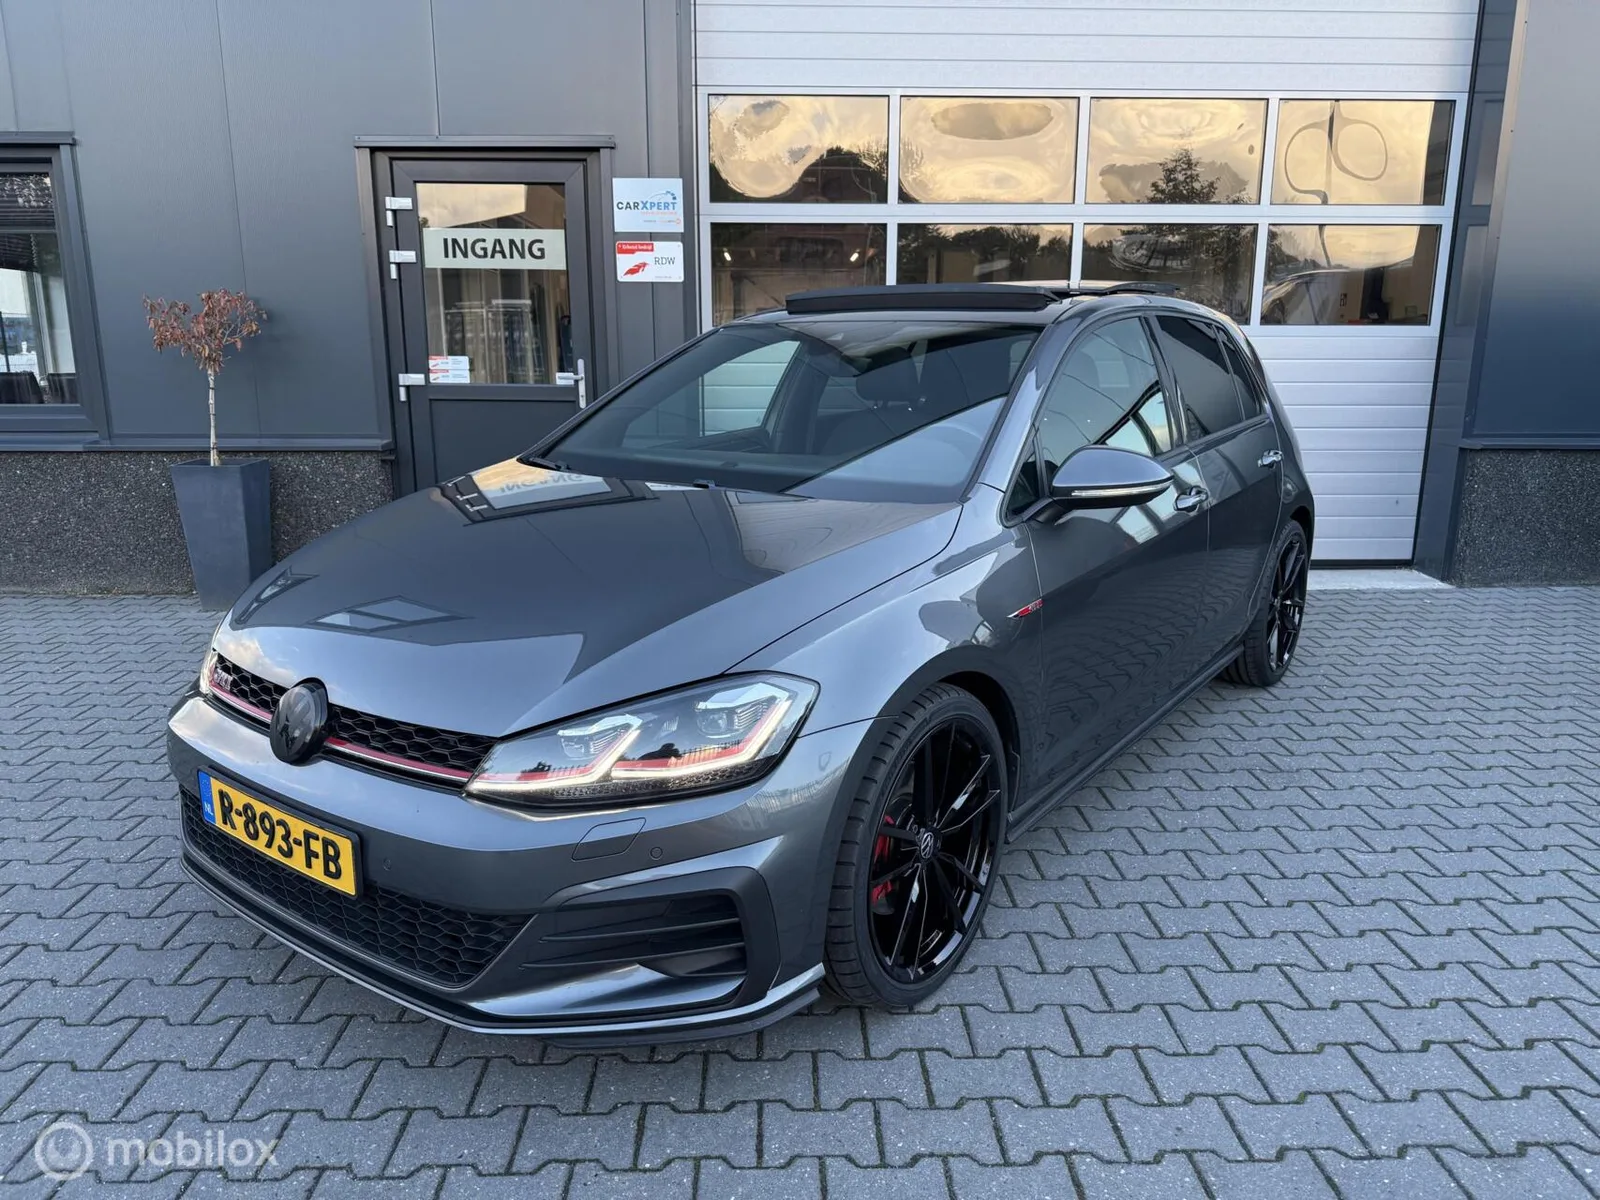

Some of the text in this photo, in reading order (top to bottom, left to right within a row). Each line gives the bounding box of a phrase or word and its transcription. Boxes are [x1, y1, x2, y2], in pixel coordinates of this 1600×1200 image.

[616, 201, 677, 210] CARXPERT
[442, 237, 546, 260] INGANG
[654, 257, 675, 265] RDW
[204, 801, 214, 816] NL
[218, 788, 342, 880] R-893-FB
